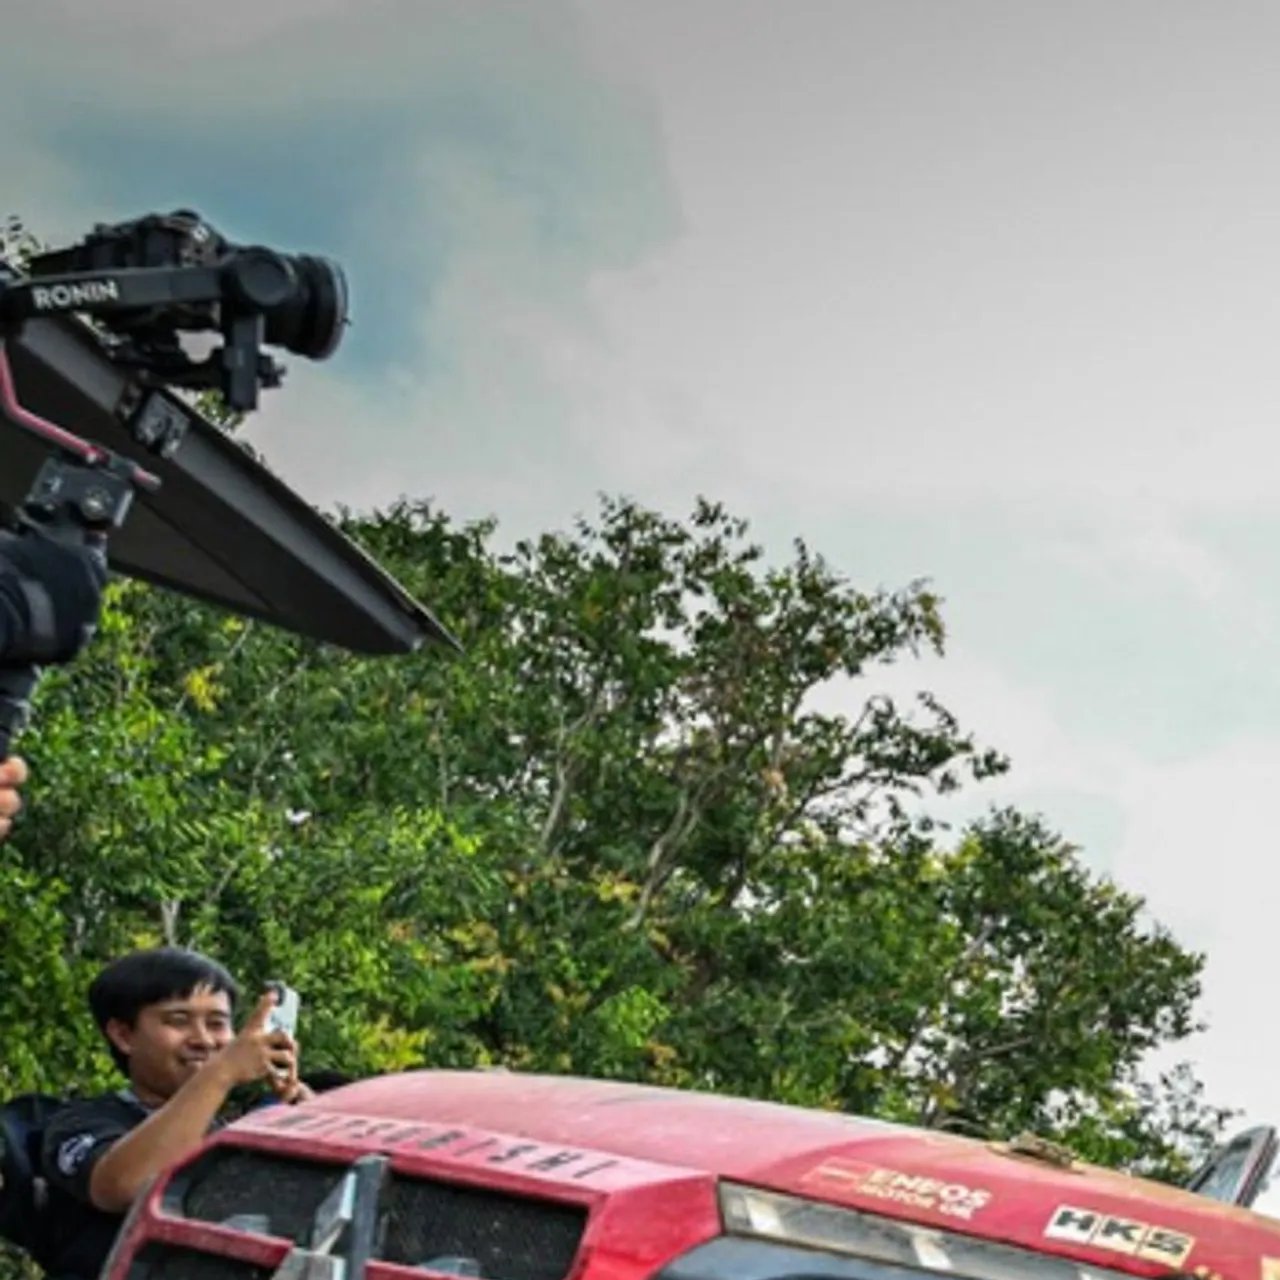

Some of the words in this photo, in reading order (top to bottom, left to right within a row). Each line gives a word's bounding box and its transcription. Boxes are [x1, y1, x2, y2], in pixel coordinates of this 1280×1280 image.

[32, 280, 119, 309] RONIN
[864, 1169, 991, 1209] ENEOS
[1053, 1207, 1190, 1259] HKS
